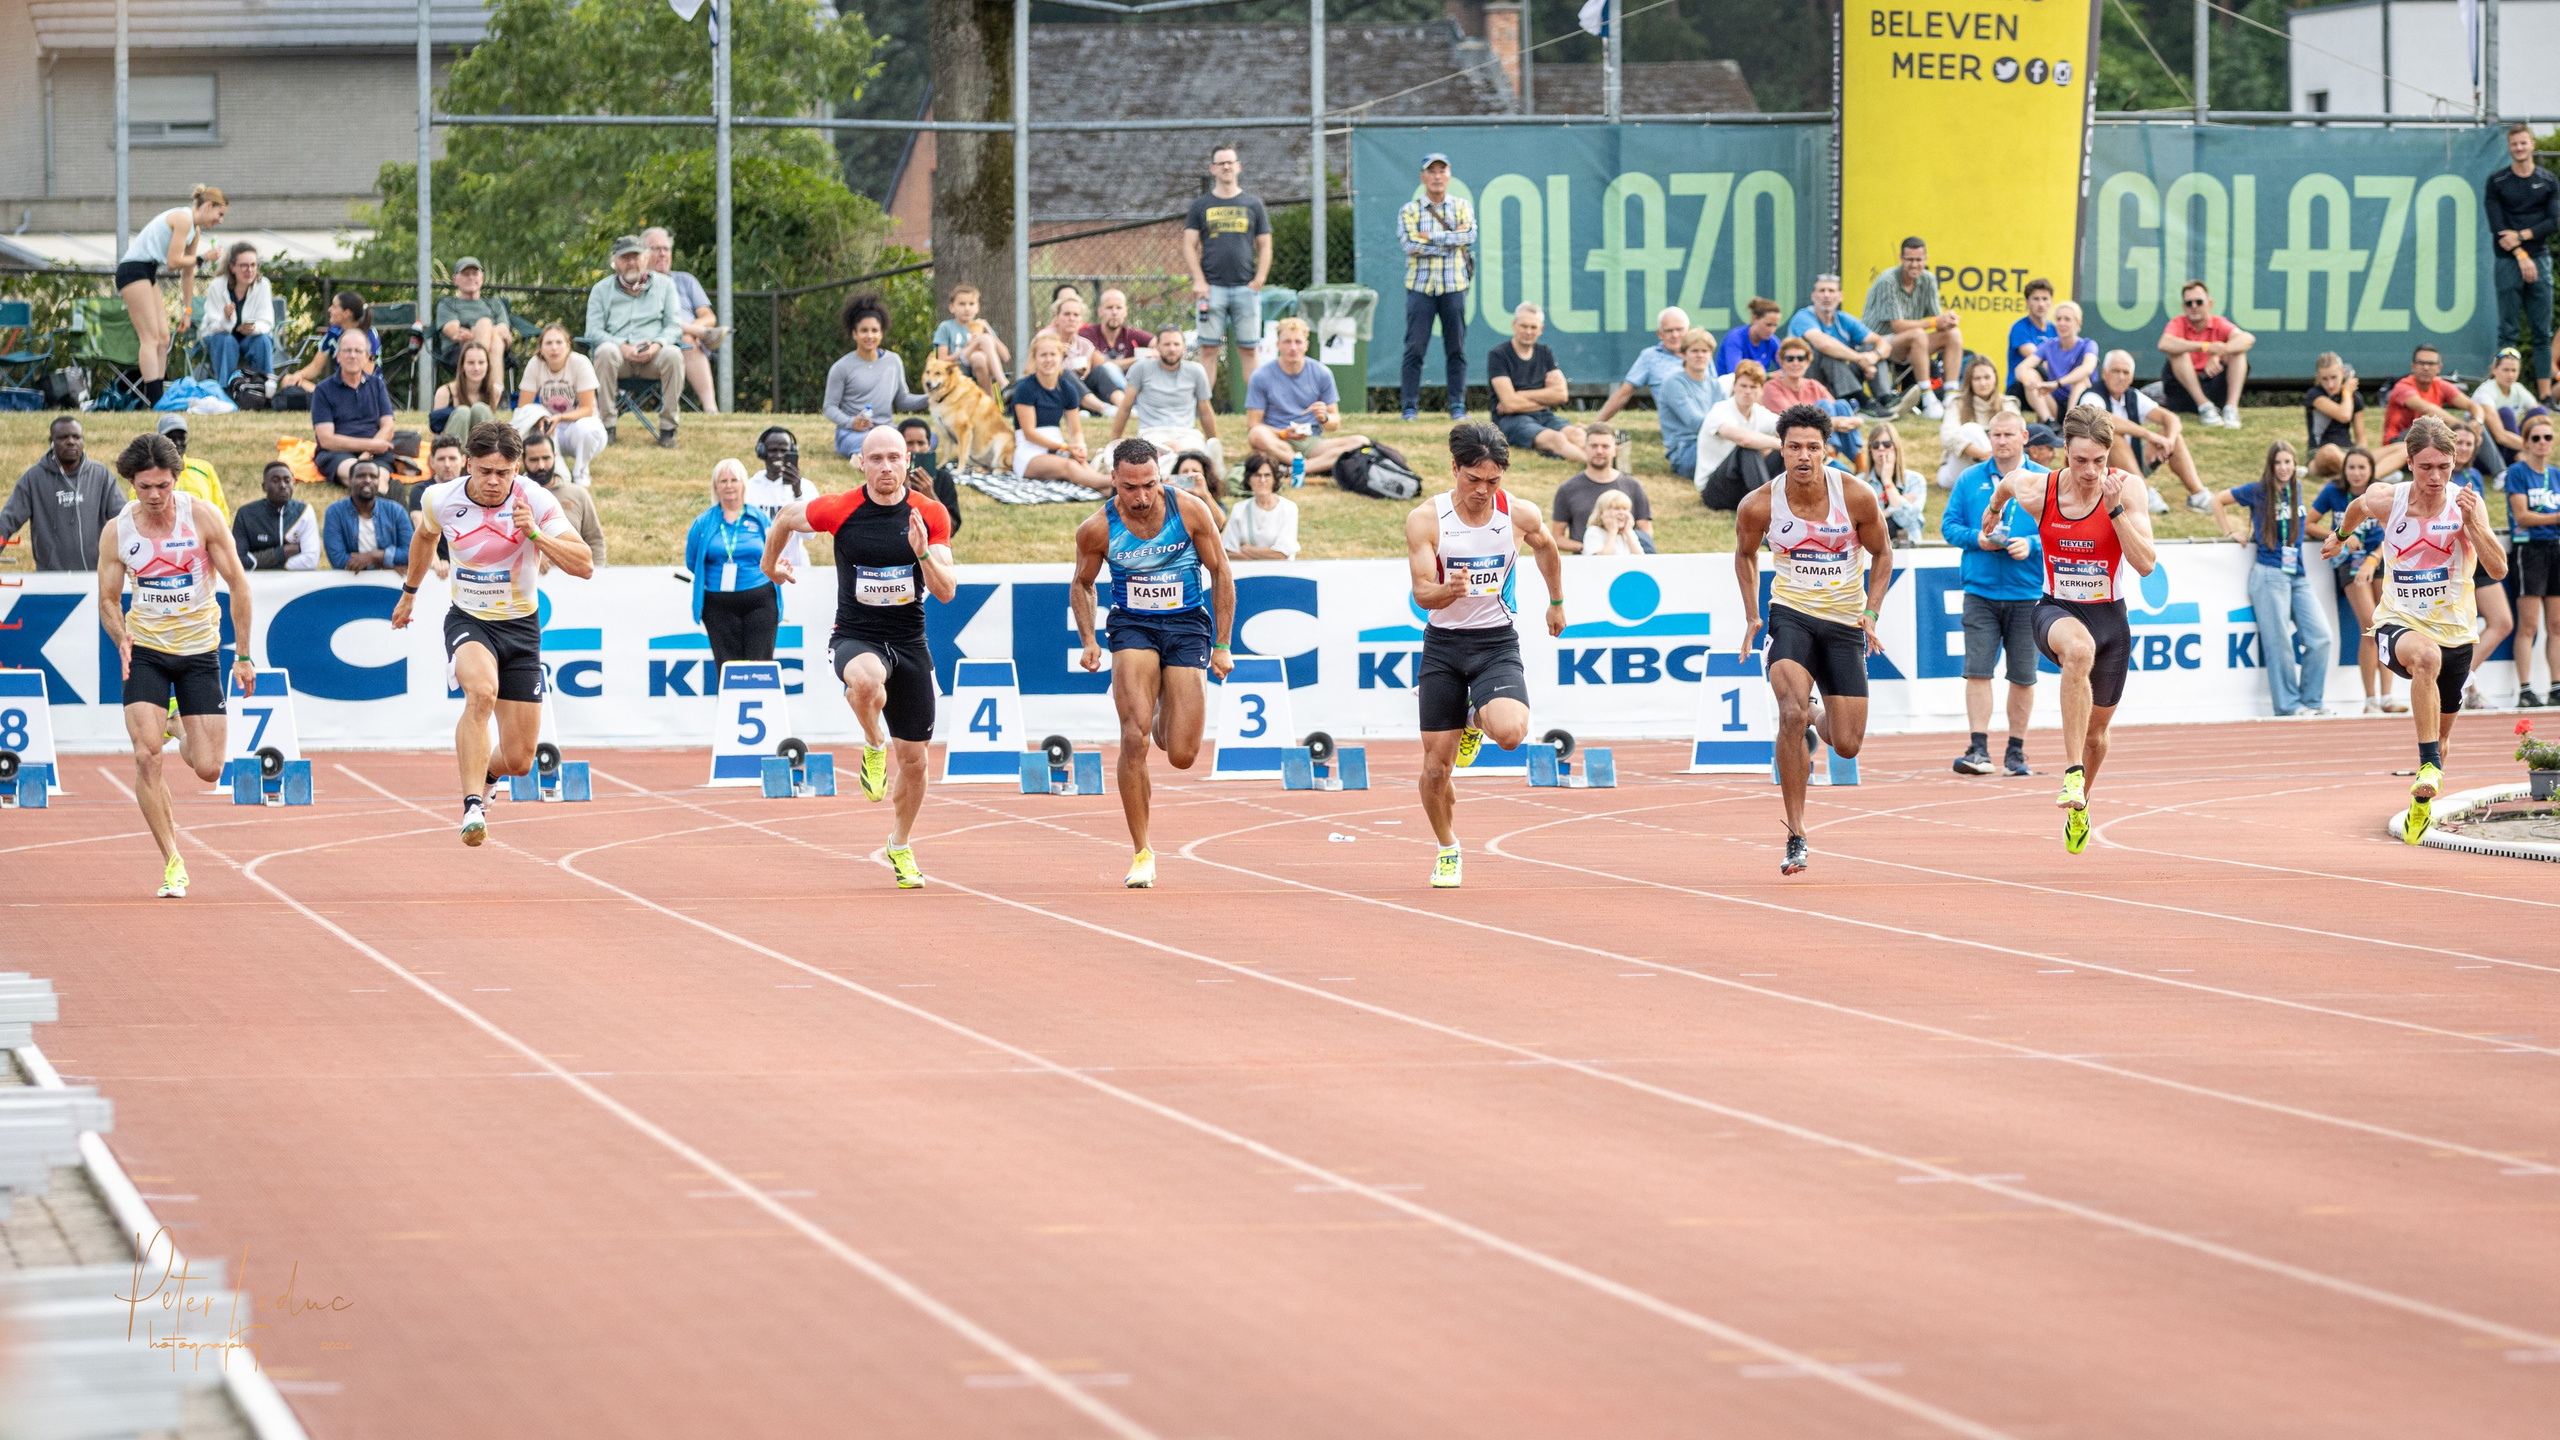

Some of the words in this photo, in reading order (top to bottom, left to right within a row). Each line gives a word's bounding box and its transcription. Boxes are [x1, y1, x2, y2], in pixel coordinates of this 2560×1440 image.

[1871, 10, 2018, 41] BELEVEN
[1892, 52, 1982, 81] MEER
[2096, 171, 2478, 334] GOLAZO
[1924, 266, 2028, 293] PORT
[1116, 541, 1186, 560] EXCELSIOR
[2060, 540, 2093, 548] HEYLEN
[1795, 565, 1842, 576] CAMARA
[2059, 580, 2104, 588] KERKHOFS
[143, 592, 191, 603] LIFRANGE
[863, 584, 907, 593] SNYDERS
[1133, 586, 1176, 598] KASMI
[2397, 587, 2409, 598] DE
[2412, 585, 2447, 598] PROFT
[1558, 645, 1711, 685] KBC
[737, 701, 766, 745] 5
[969, 698, 1002, 742] 4
[1239, 694, 1267, 739] 3
[1721, 688, 1748, 731] 1
[0, 708, 29, 752] 8
[242, 708, 274, 752] 7
